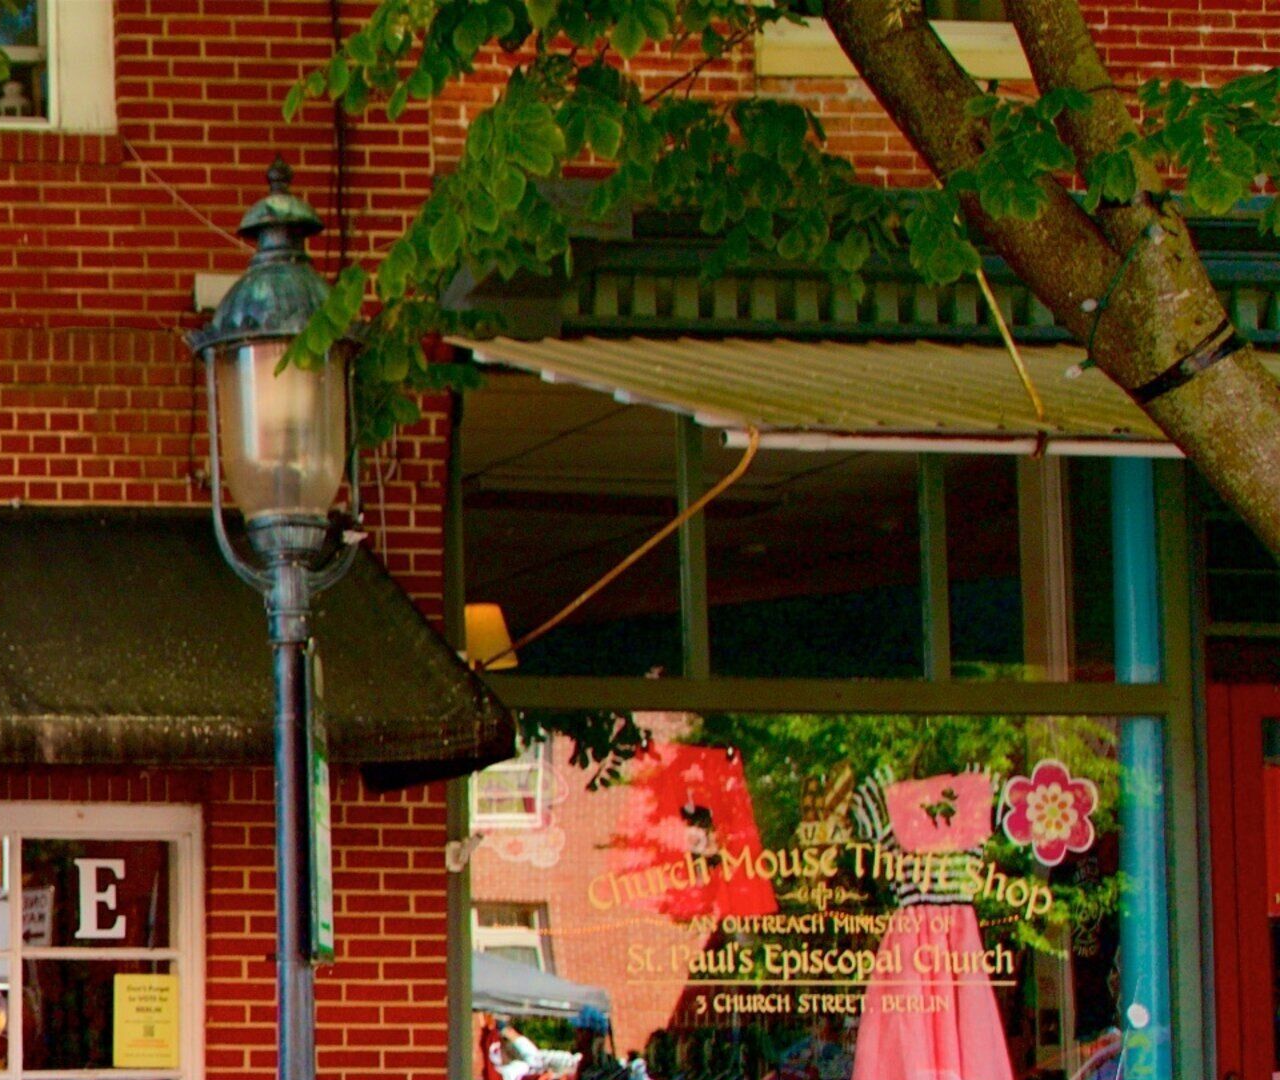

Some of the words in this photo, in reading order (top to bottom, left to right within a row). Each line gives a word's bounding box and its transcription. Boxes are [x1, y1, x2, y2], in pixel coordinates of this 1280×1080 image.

[589, 853, 711, 909] Church
[719, 845, 839, 882] Mouse
[845, 843, 950, 893] Thrift
[960, 857, 1052, 920] Shop
[689, 915, 718, 934] AN
[722, 914, 825, 934] OUTREACH
[833, 913, 923, 935] MINISTRY
[930, 915, 954, 935] OF
[627, 944, 662, 974] St.
[671, 942, 755, 974] Paul's
[762, 942, 903, 980] Episcopal
[913, 944, 1014, 974] Church
[695, 995, 707, 1014] 3
[713, 993, 791, 1013] CHURCH
[882, 993, 950, 1013] BERLIN
